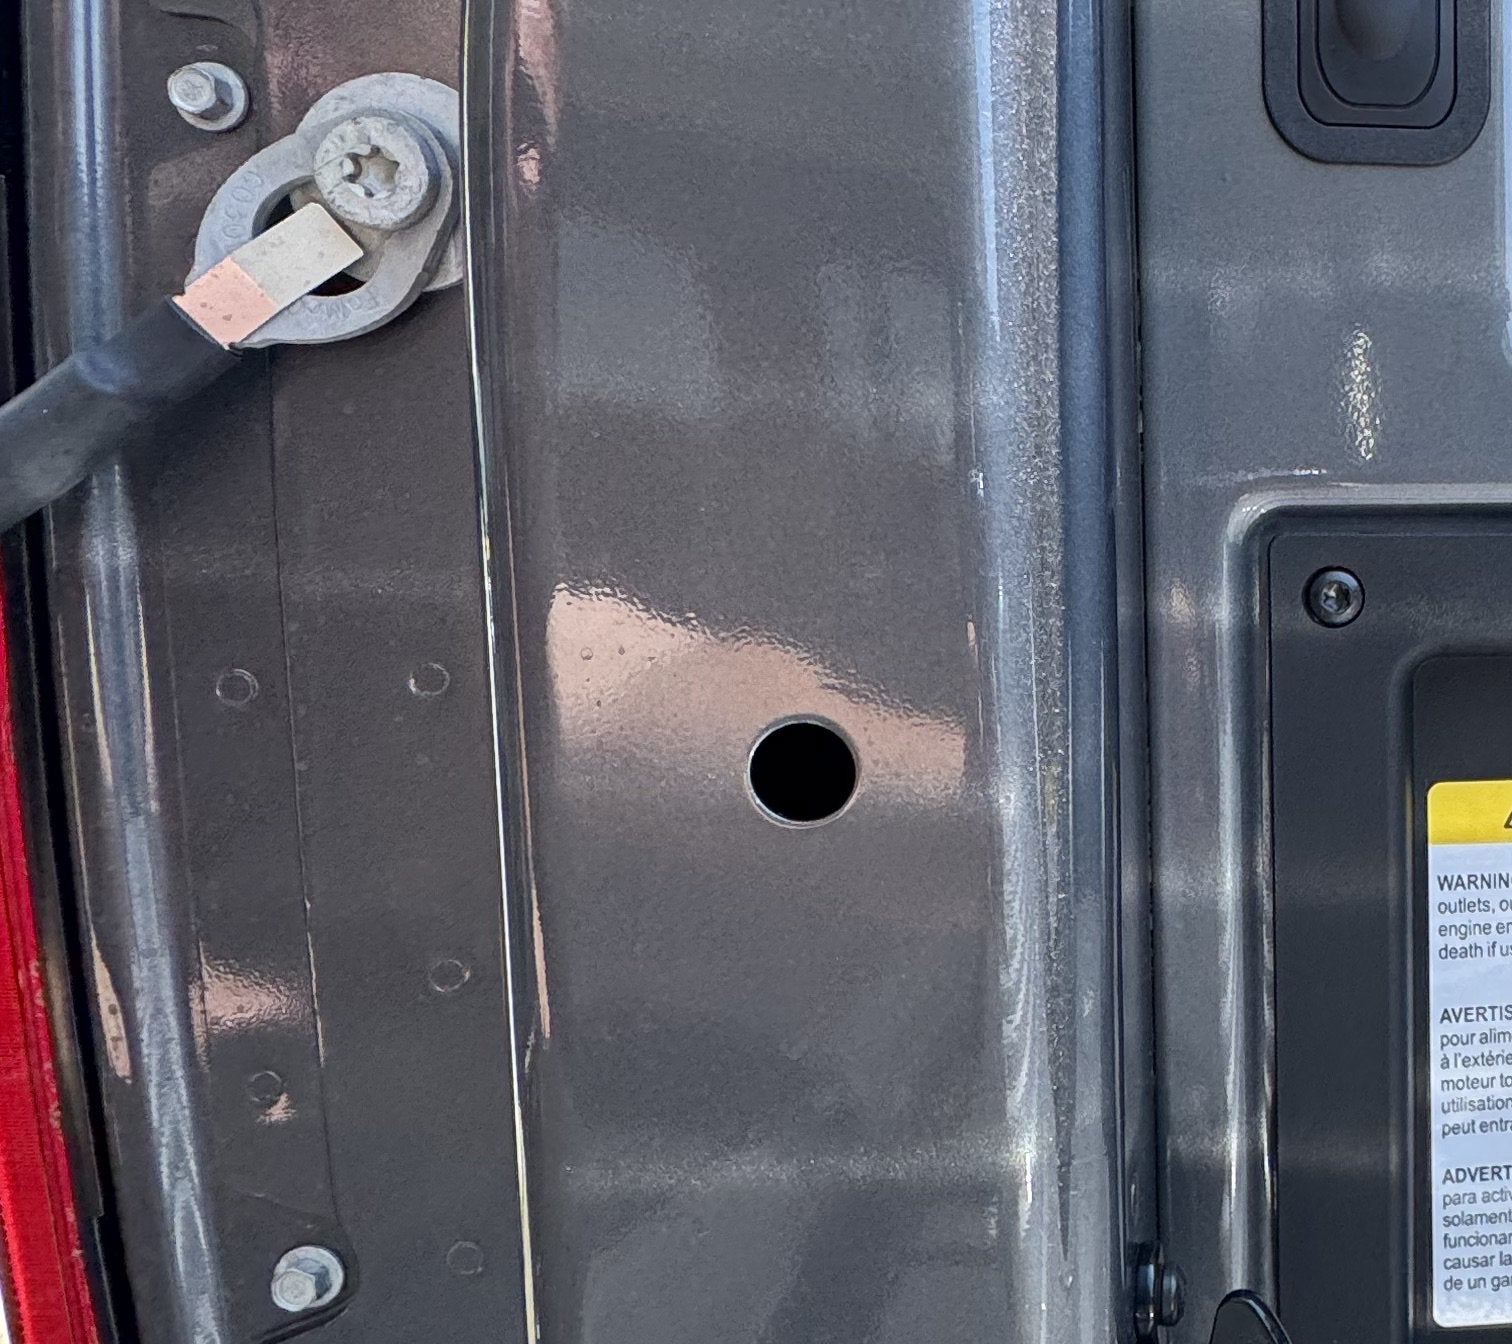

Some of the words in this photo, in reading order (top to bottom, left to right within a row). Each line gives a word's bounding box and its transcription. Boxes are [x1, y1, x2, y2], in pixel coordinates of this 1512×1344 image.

[1437, 894, 1495, 916] outlets,
[1438, 917, 1492, 940] engine
[1437, 940, 1484, 958] death
[1486, 939, 1497, 957] if
[1440, 1031, 1476, 1050] pour
[1439, 1051, 1450, 1068] à
[1440, 1072, 1497, 1090] moteur
[1441, 1117, 1476, 1139] peut
[1442, 1190, 1477, 1208] para
[1442, 1253, 1496, 1269] causar
[1499, 1248, 1512, 1266] la
[1443, 1272, 1463, 1290] de
[1467, 1275, 1486, 1289] un
